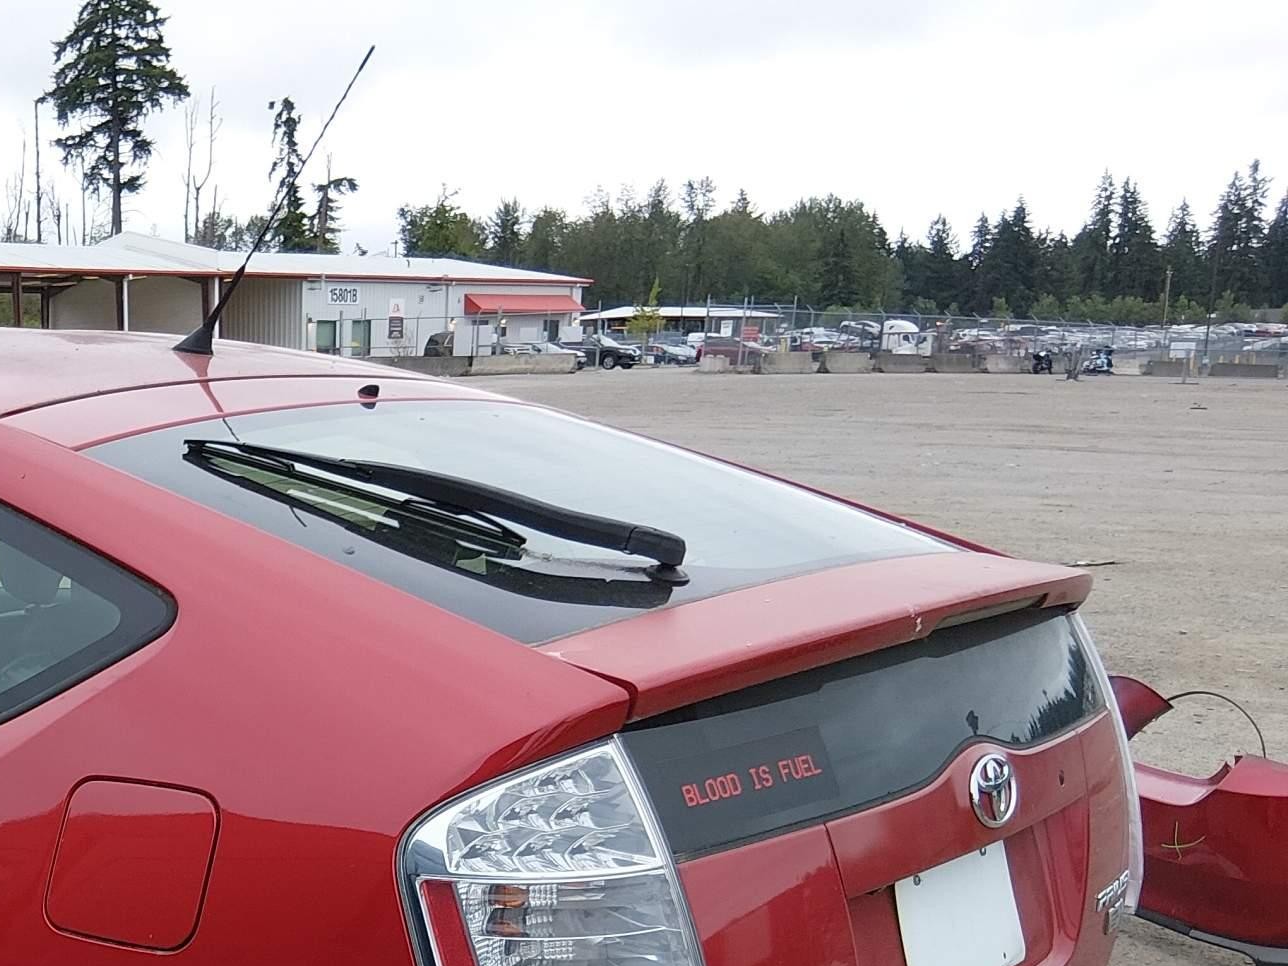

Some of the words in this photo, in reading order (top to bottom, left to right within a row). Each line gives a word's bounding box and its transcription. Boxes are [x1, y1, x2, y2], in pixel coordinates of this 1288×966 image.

[329, 287, 358, 303] 15801B
[682, 774, 742, 807] BLOOD
[748, 765, 773, 790] IS
[778, 755, 822, 782] FUEL
